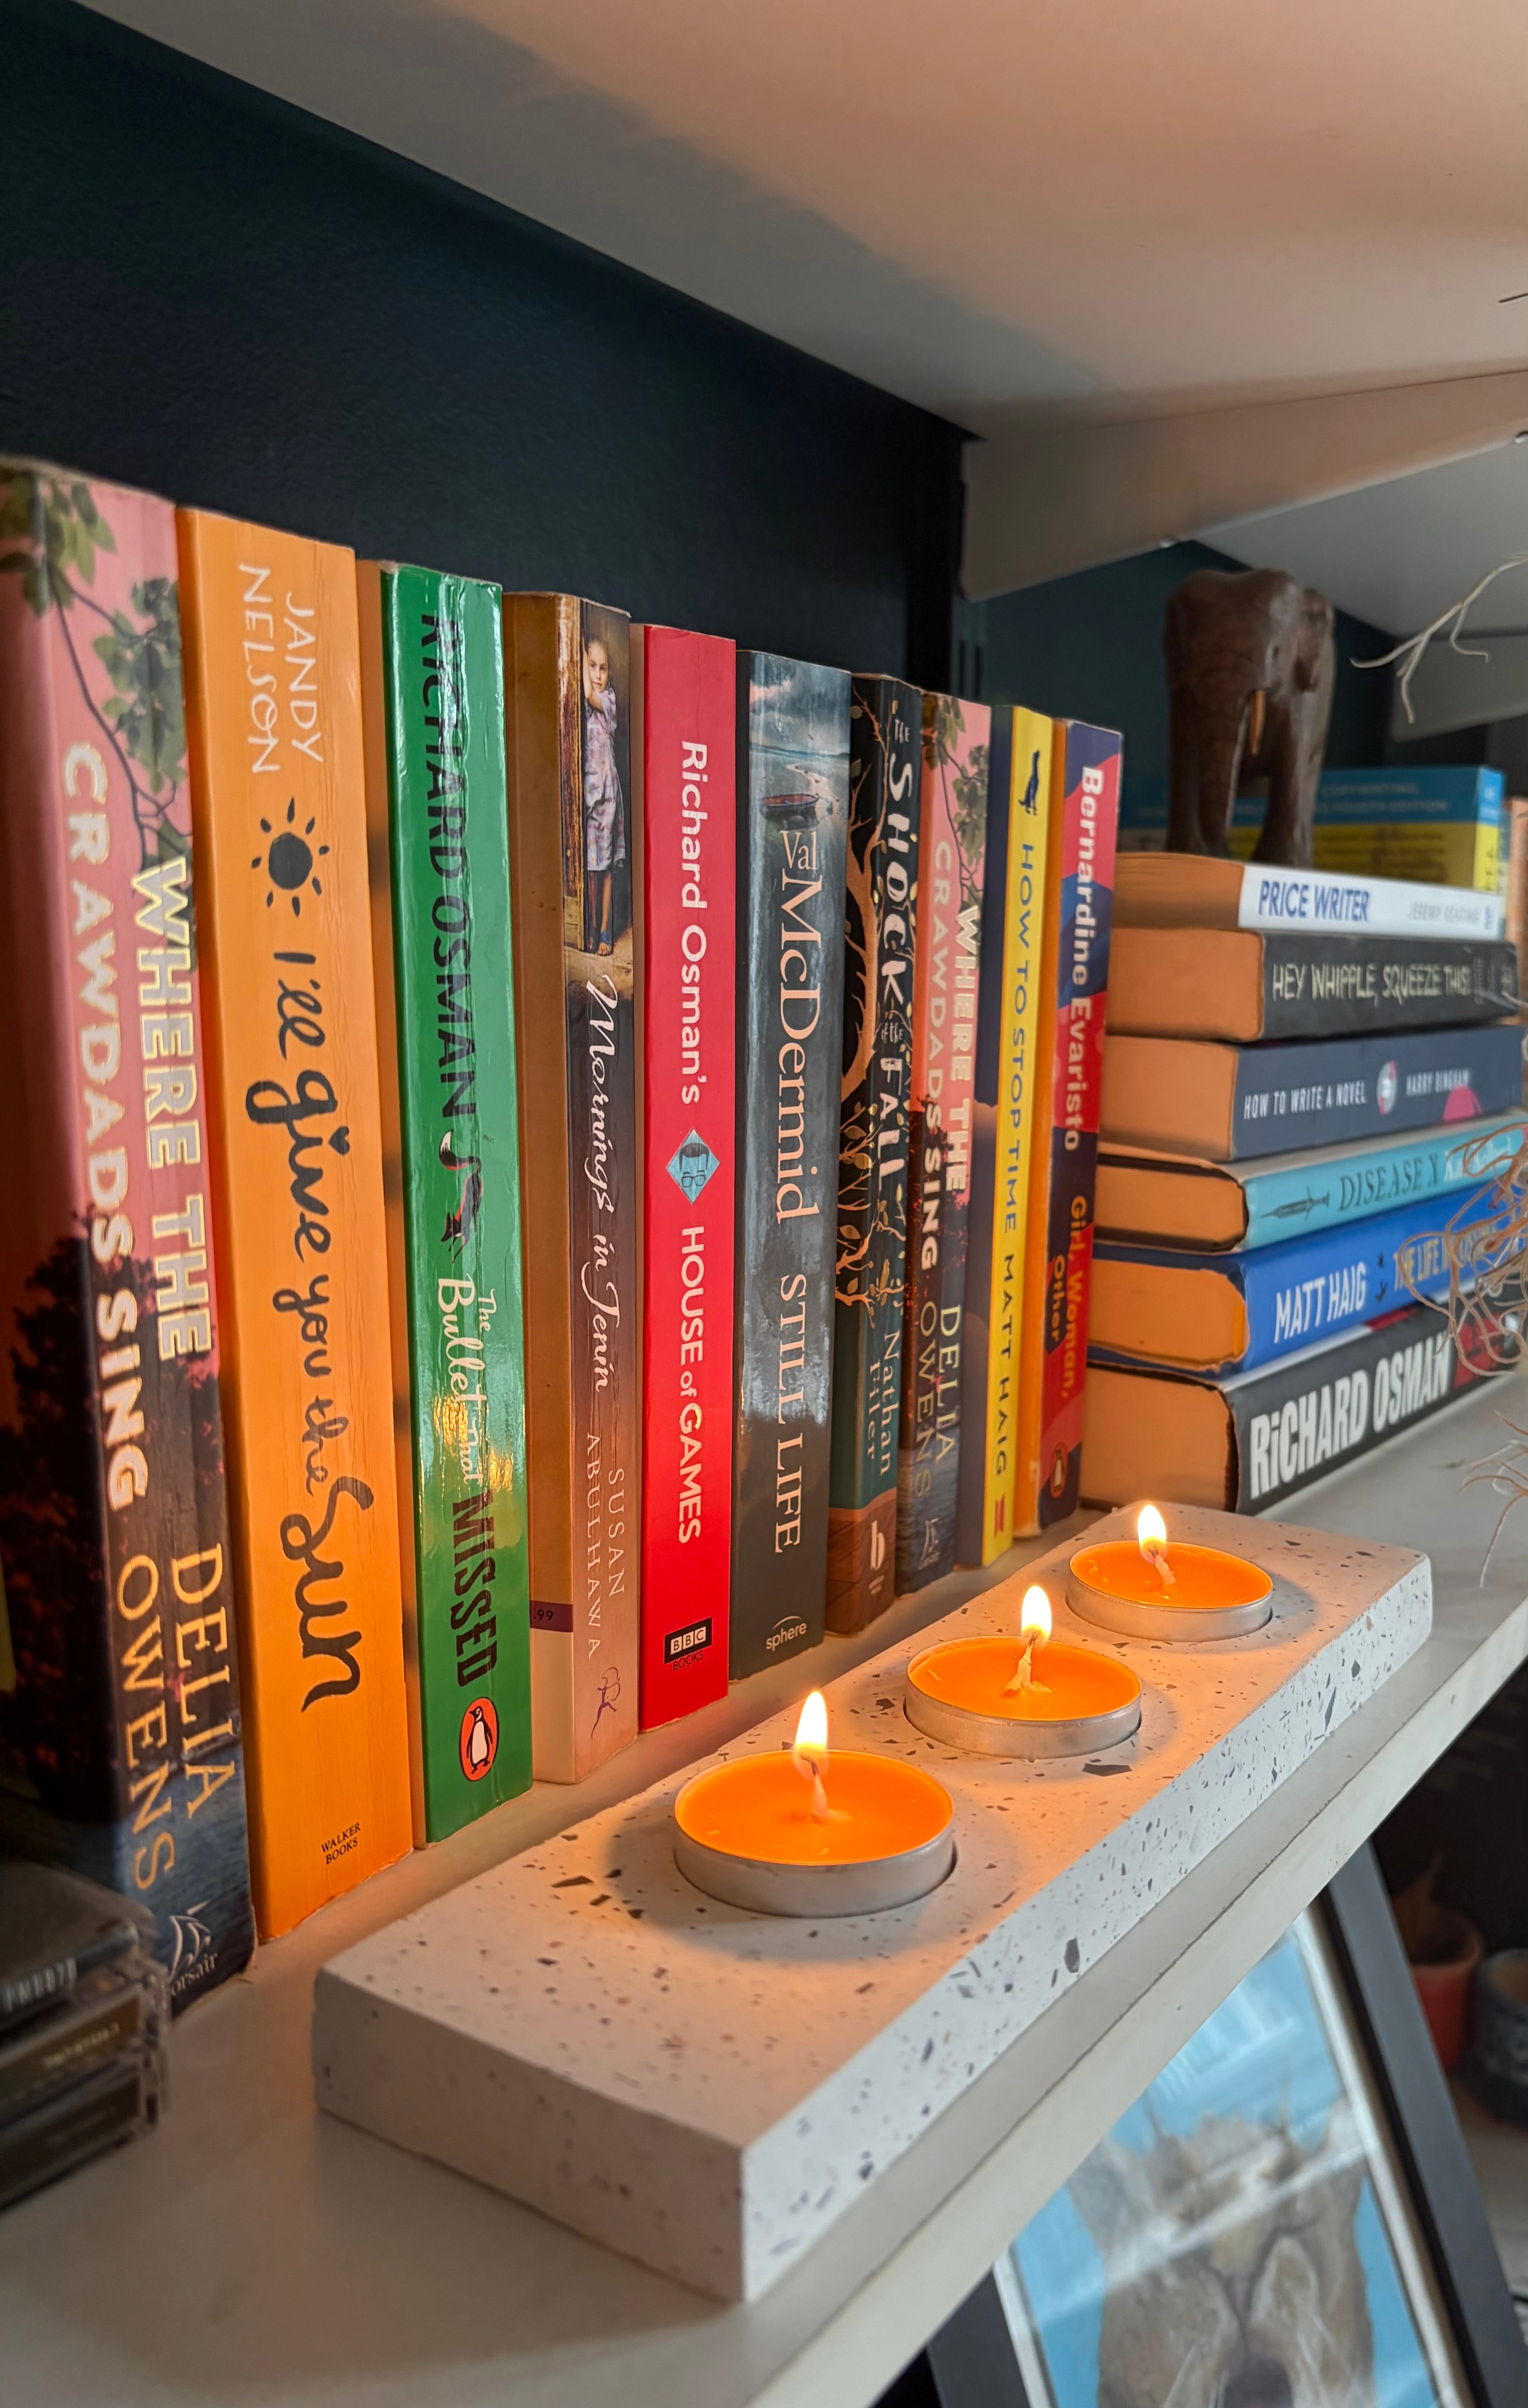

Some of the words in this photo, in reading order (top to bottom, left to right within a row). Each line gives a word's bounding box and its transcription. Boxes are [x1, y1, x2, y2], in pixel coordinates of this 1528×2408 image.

[239, 562, 280, 774] NELSON
[284, 592, 324, 763] JANDY
[420, 614, 467, 880] RICHARD
[681, 740, 708, 909] Richard
[780, 830, 818, 871] Val
[881, 753, 913, 1004] SHOCK
[1072, 766, 1104, 986] Bernardine
[1018, 843, 1034, 949] HOW
[1258, 880, 1309, 918] PRICE
[1314, 886, 1370, 921] WRITER
[65, 742, 133, 1264] CRAWDADS
[133, 857, 201, 1170] WHERE
[273, 951, 327, 1061] I'll
[431, 894, 477, 1118] OSMAN
[681, 924, 707, 1105] Osman's
[777, 870, 822, 1224] McDermid
[925, 840, 951, 1130] CRAWDADS
[950, 904, 979, 1082] WHERE
[1015, 959, 1028, 1015] TO
[1273, 963, 1305, 1001] HEY
[1311, 963, 1378, 1008] WHIPPLE,
[1382, 963, 1442, 1006] SQUEEZE
[584, 974, 618, 1213] Mornings
[878, 1058, 905, 1193] FALL
[1010, 1027, 1025, 1129] STOP
[1065, 997, 1092, 1151] Evaristo
[1244, 1094, 1268, 1120] HOW
[1273, 1092, 1286, 1115] TO
[1290, 1086, 1322, 1112] WRITE
[1325, 1086, 1333, 1108] A
[1336, 1081, 1367, 1106] NOVEL
[1406, 1071, 1433, 1096] HARRY
[245, 1069, 350, 1261] give
[921, 1145, 940, 1271] SING
[945, 1098, 971, 1192] THE
[1005, 1139, 1020, 1233] TIME
[1339, 1158, 1422, 1212] DISEASE
[1427, 1152, 1439, 1187] X
[152, 1194, 212, 1362] THE
[477, 1288, 497, 1332] The
[593, 1233, 615, 1271] in
[681, 1226, 705, 1366] HOUSE
[1001, 1254, 1014, 1360] MATT
[1052, 1254, 1064, 1342] Other
[1274, 1277, 1325, 1344] MATT
[1327, 1261, 1366, 1322] HAIG
[1417, 1237, 1439, 1281] LIFE
[273, 1274, 332, 1378] you
[437, 1273, 487, 1410] Bullet
[581, 1261, 620, 1393] Jenin
[680, 1371, 697, 1397] of
[778, 1273, 807, 1425] STILL
[935, 1304, 961, 1463] DELIA
[1373, 1327, 1453, 1433] OSMAN
[96, 1288, 148, 1511] SING
[302, 1395, 349, 1497] the
[868, 1359, 880, 1459] Filer
[881, 1329, 900, 1476] Nathan
[915, 1301, 937, 1498] OWENS
[995, 1376, 1010, 1476] HAIG
[608, 1468, 625, 1598] SUSAN
[678, 1403, 703, 1544] GAMES
[775, 1432, 803, 1553] LIFE
[280, 1476, 374, 1713] Sun
[451, 1489, 498, 1687] MISSED
[587, 1433, 602, 1660] ABULHAWA
[171, 1543, 236, 1820] DELIA
[672, 1628, 705, 1653] BBC
[673, 1650, 704, 1671] BOOKS
[766, 1623, 807, 1651] sphere
[116, 1554, 175, 1891] OWENS
[321, 1823, 361, 1852] WALKER
[326, 1837, 357, 1865] BOOKS
[170, 1953, 218, 1997] orsair
